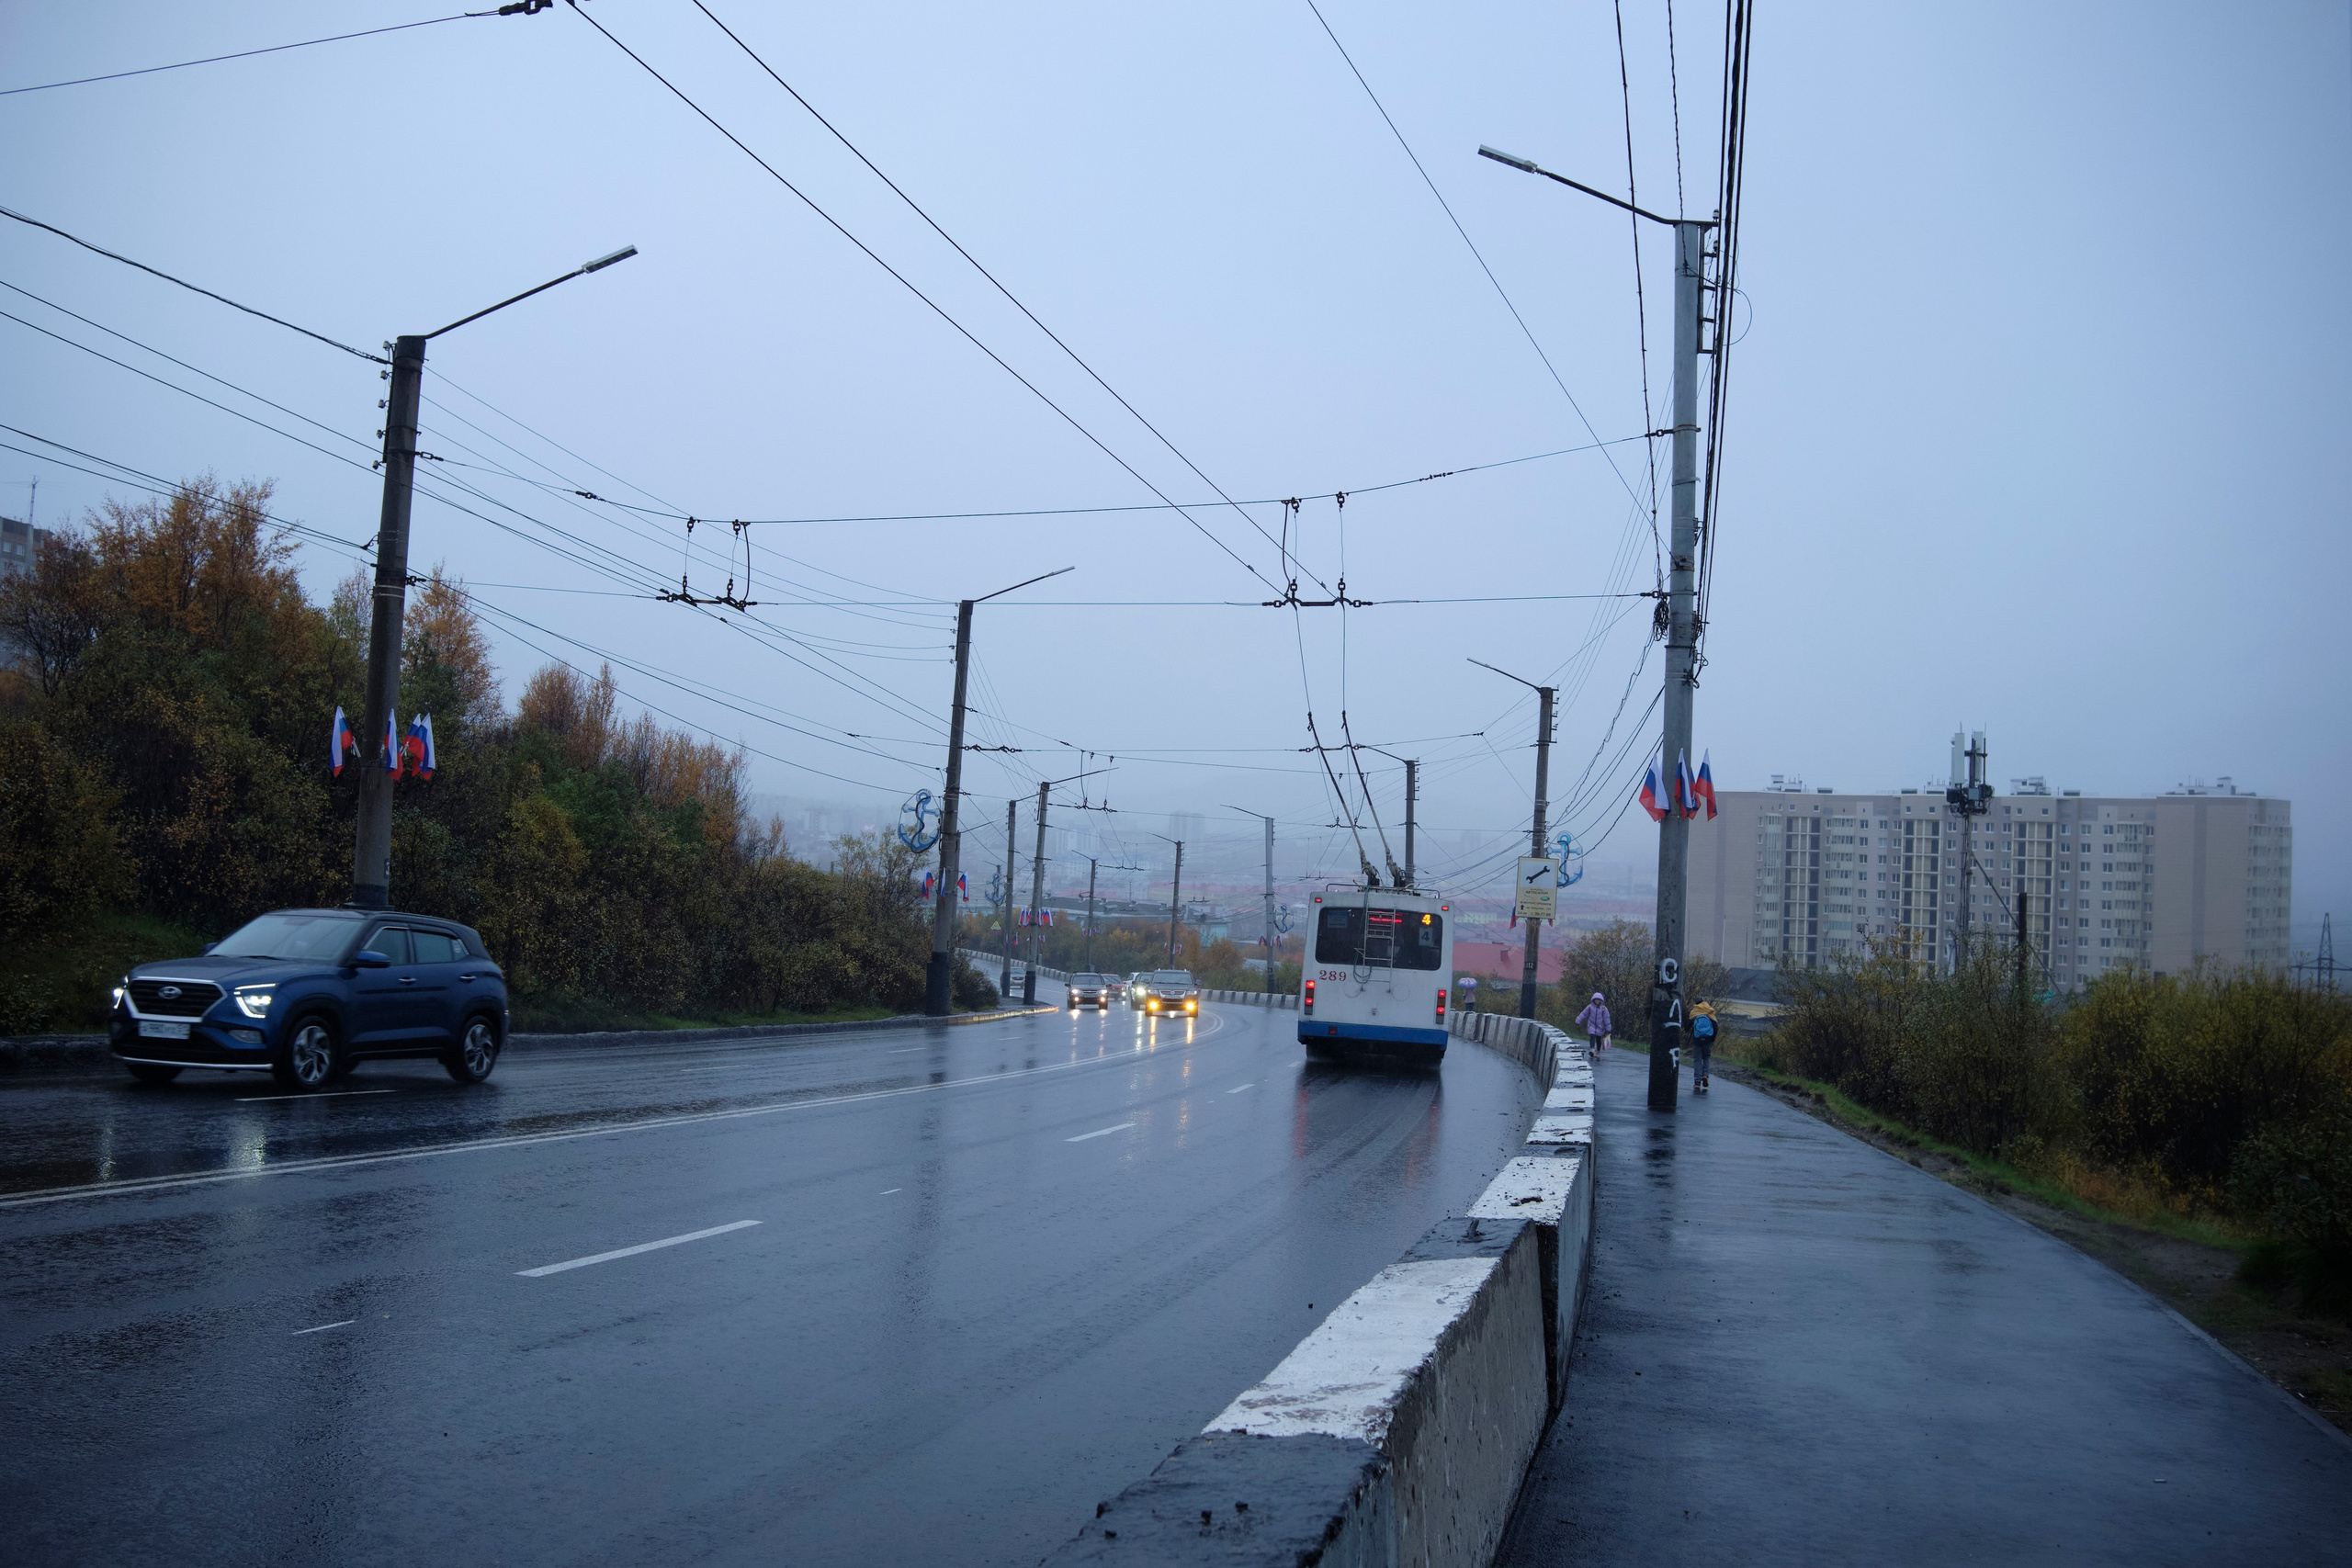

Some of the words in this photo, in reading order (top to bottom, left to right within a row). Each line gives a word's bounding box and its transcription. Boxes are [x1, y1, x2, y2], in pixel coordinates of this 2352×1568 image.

[1421, 914, 1431, 925] 4
[1421, 931, 1430, 942] 4
[1318, 969, 1347, 982] 289
